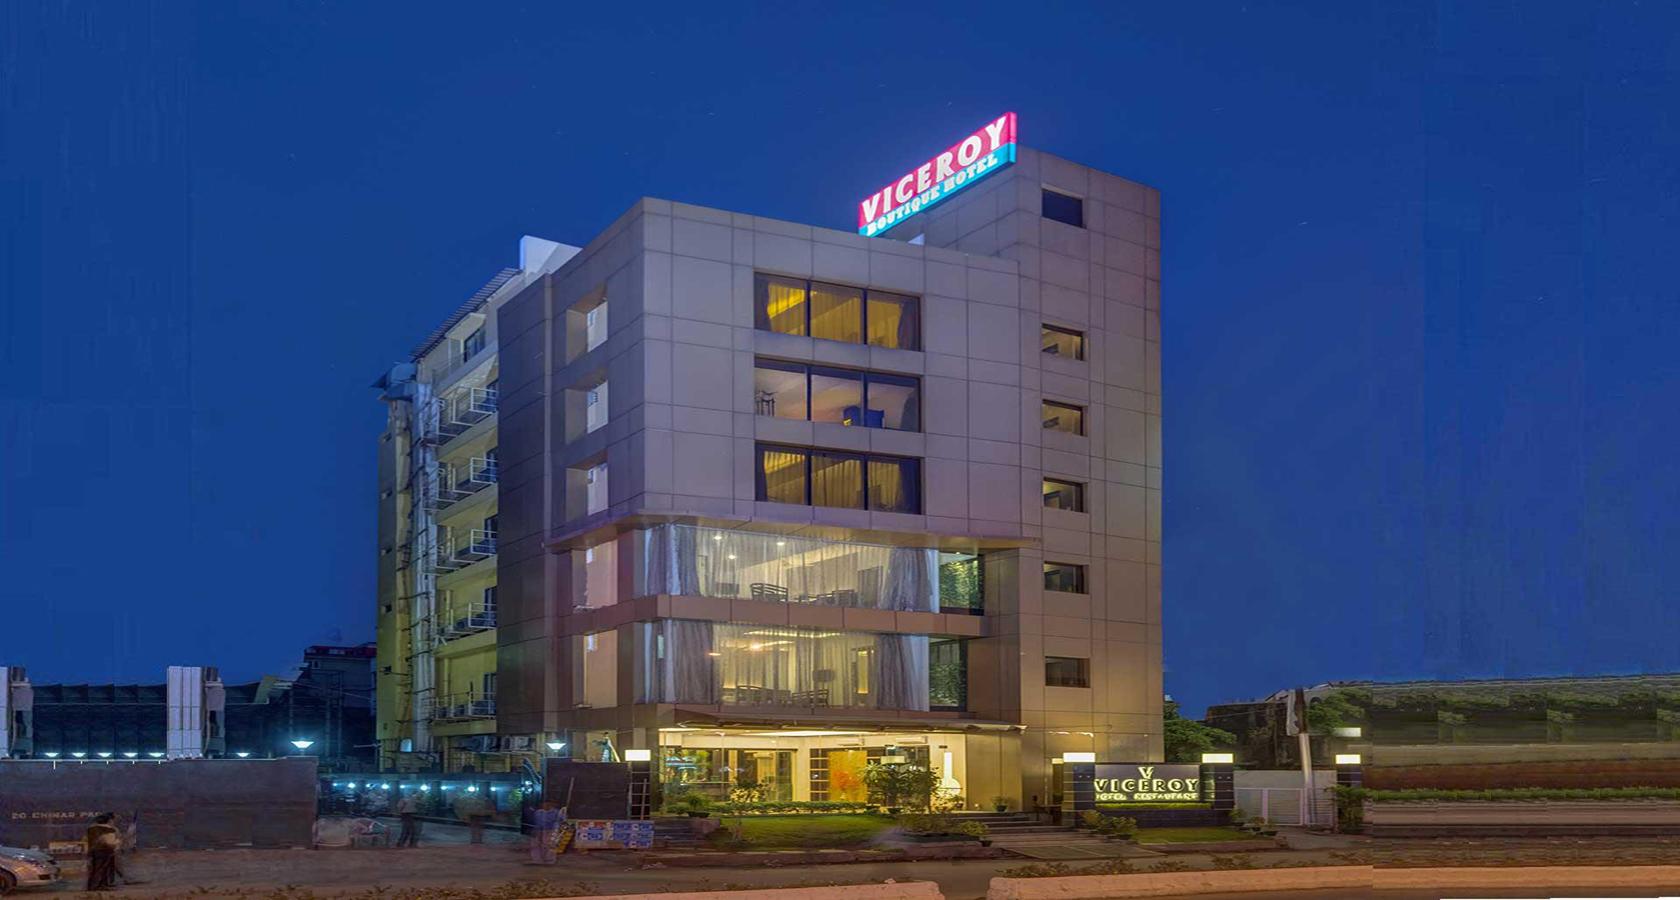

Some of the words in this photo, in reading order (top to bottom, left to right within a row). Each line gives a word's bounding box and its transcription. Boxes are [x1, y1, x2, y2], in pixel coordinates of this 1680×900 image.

[861, 115, 1007, 223] VICEROY
[866, 186, 941, 237] BOUTIQUE
[943, 153, 998, 192] HOTEL
[1094, 778, 1200, 792] VICEROY
